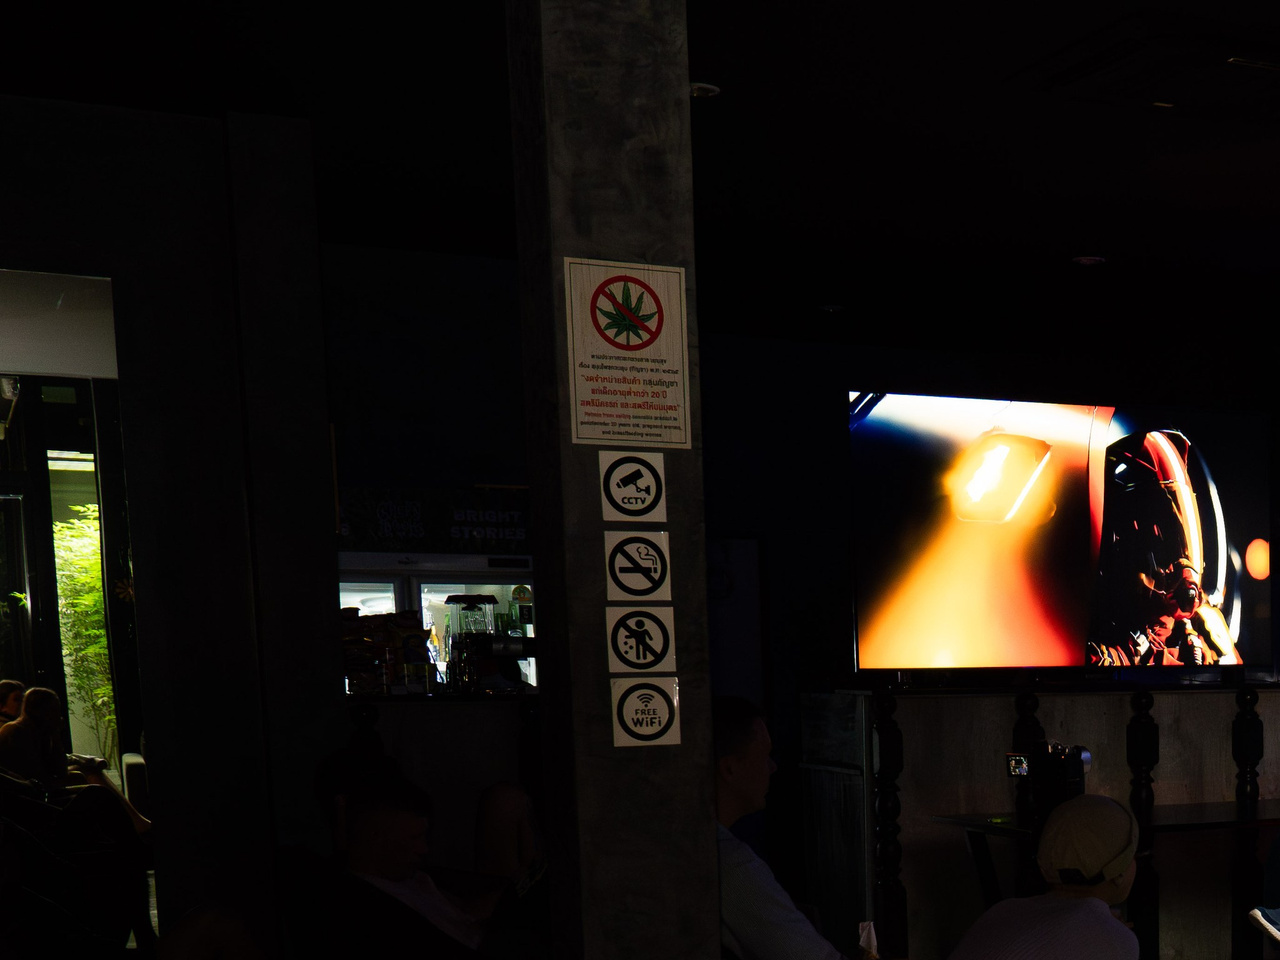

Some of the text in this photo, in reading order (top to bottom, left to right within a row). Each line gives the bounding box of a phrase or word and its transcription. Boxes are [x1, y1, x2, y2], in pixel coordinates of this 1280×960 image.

[651, 391, 660, 399] 20
[621, 496, 647, 505] CCTV
[450, 526, 527, 540] STORIES
[635, 708, 658, 716] FREE
[631, 716, 662, 728] WiFi
